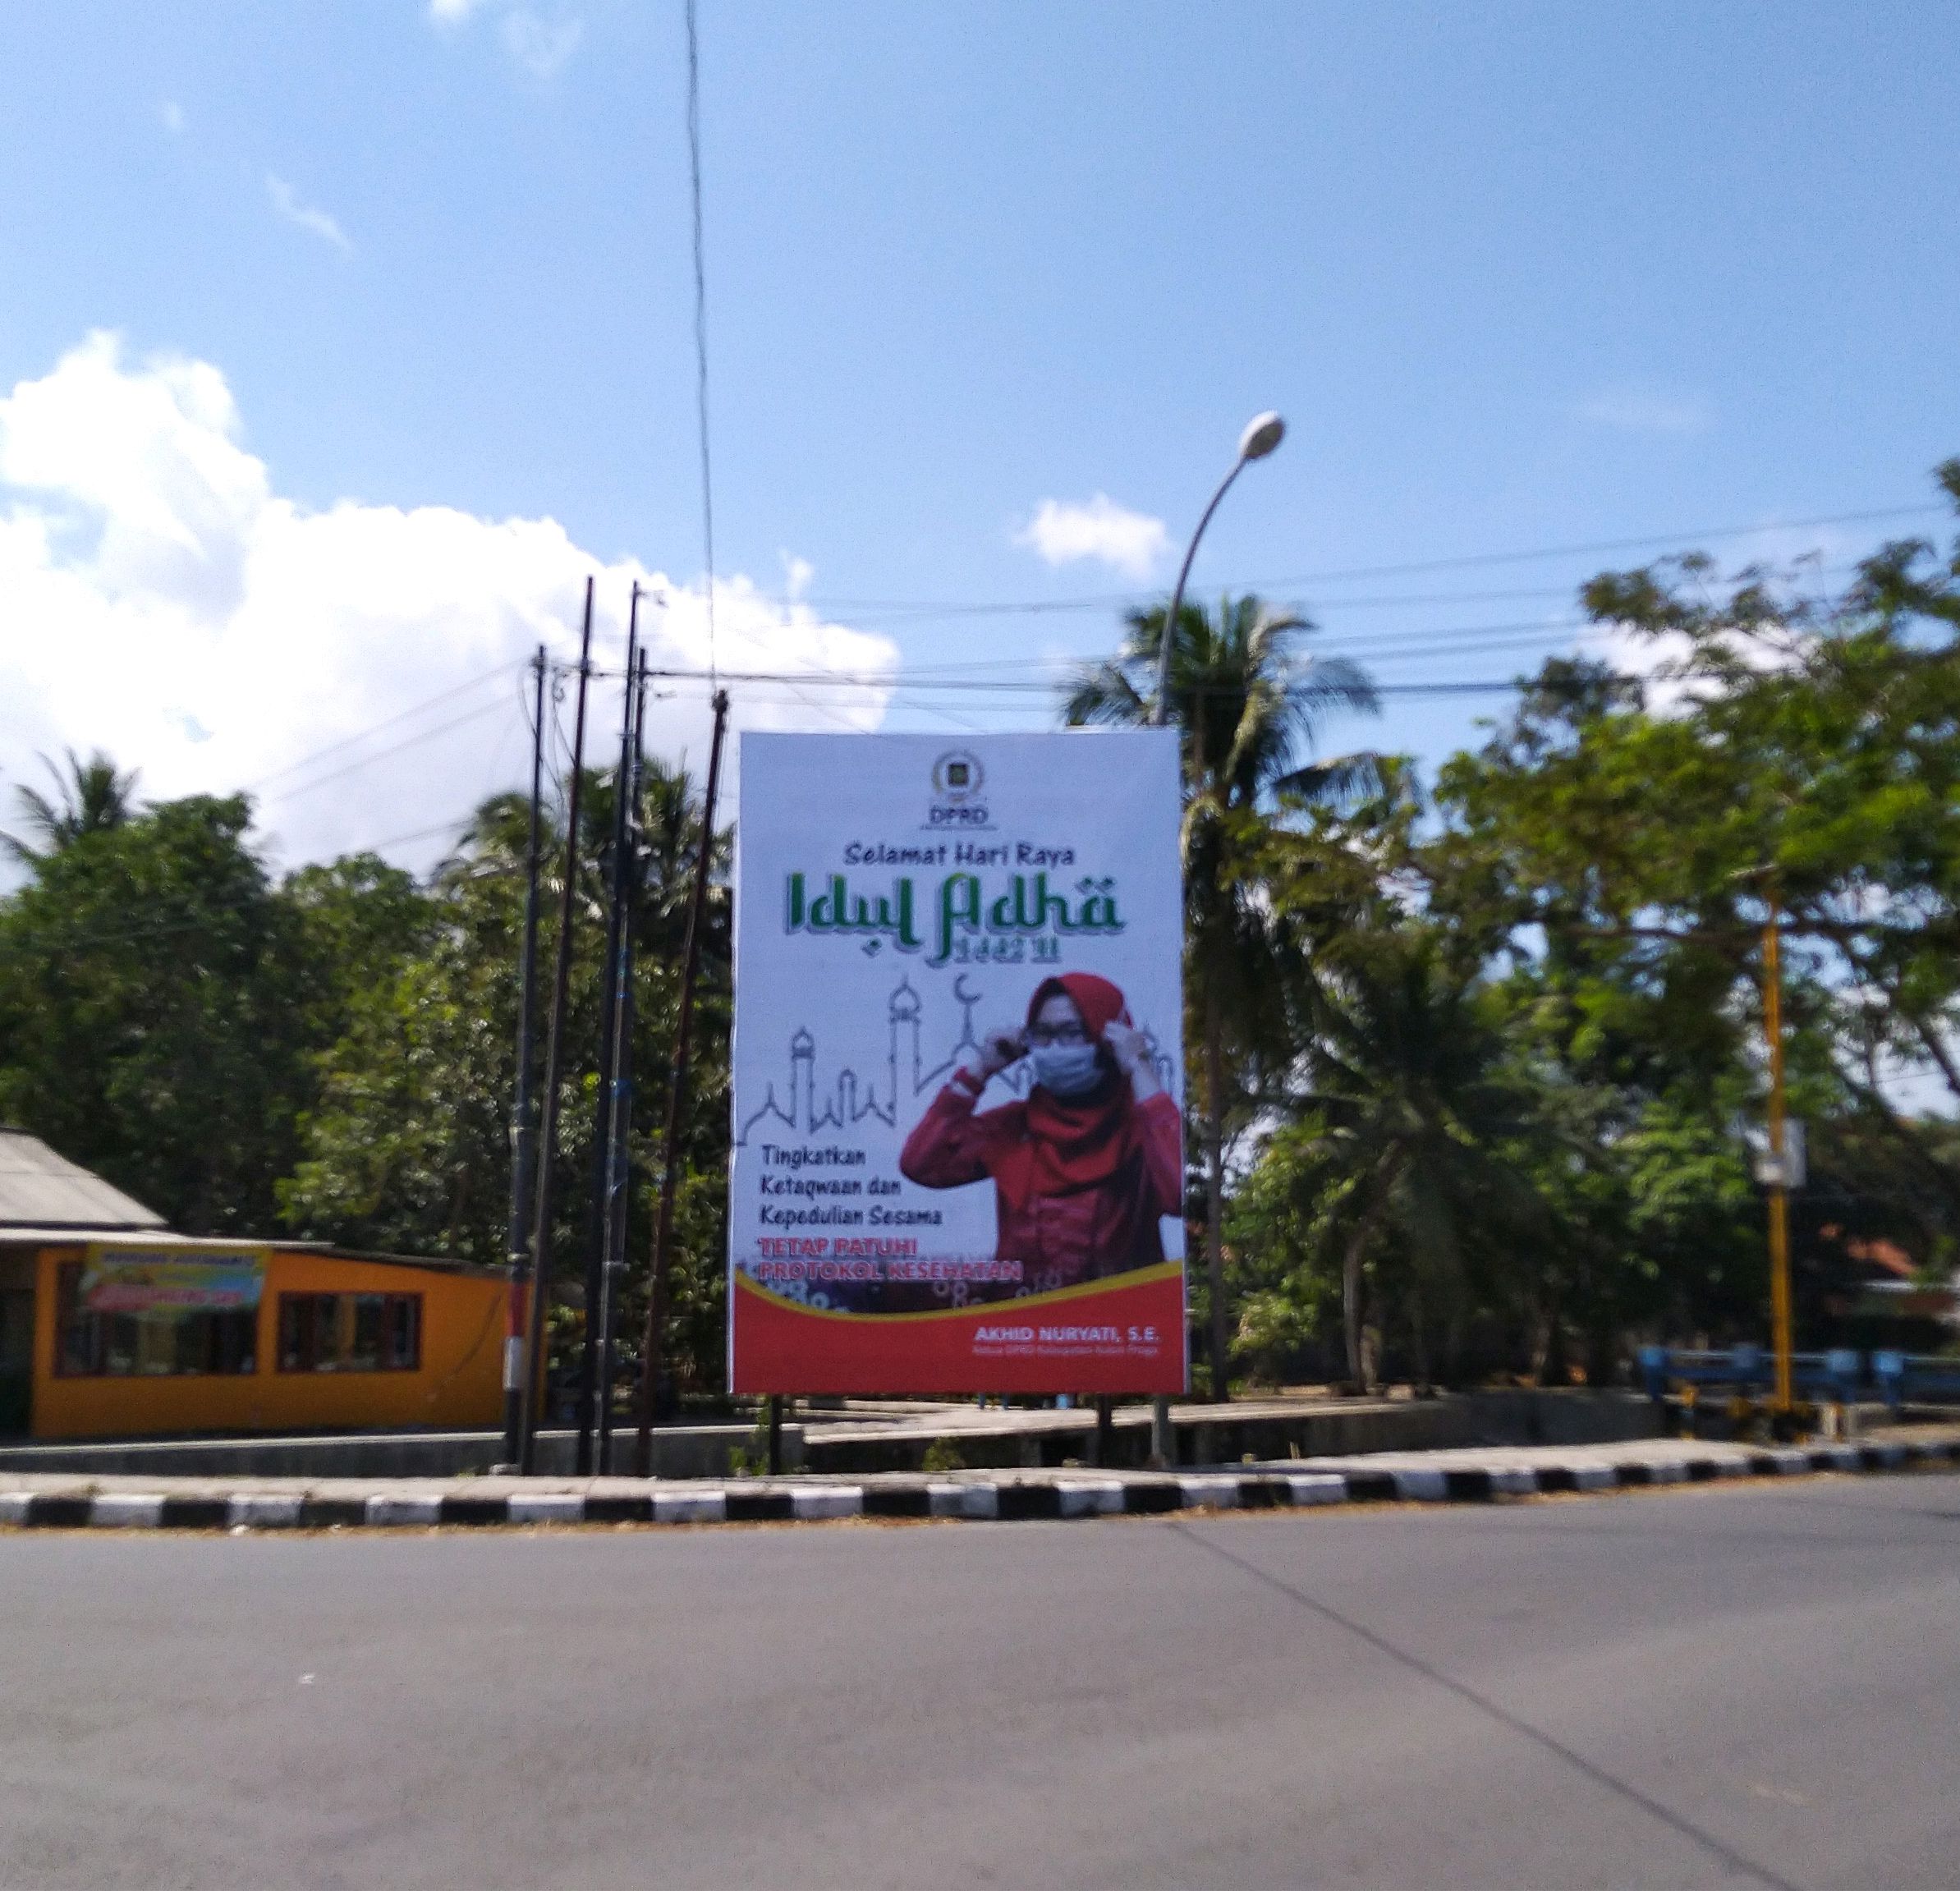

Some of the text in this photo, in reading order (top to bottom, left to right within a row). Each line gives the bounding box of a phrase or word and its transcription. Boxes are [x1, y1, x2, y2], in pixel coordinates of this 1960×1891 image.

[844, 842, 1074, 868] Selamat Hari Raya
[787, 873, 921, 957] Idul
[763, 1146, 865, 1169] Tingkatkan
[760, 1177, 901, 1200] Ketaqwaan dan
[760, 1206, 942, 1229] Kepedulian Sesama
[759, 1238, 917, 1255] TETAP PATUHI
[759, 1261, 1023, 1281] PROTOKOL KESEHATAN
[975, 1327, 1032, 1342] AKHID
[1040, 1327, 1121, 1343] NURYATI,
